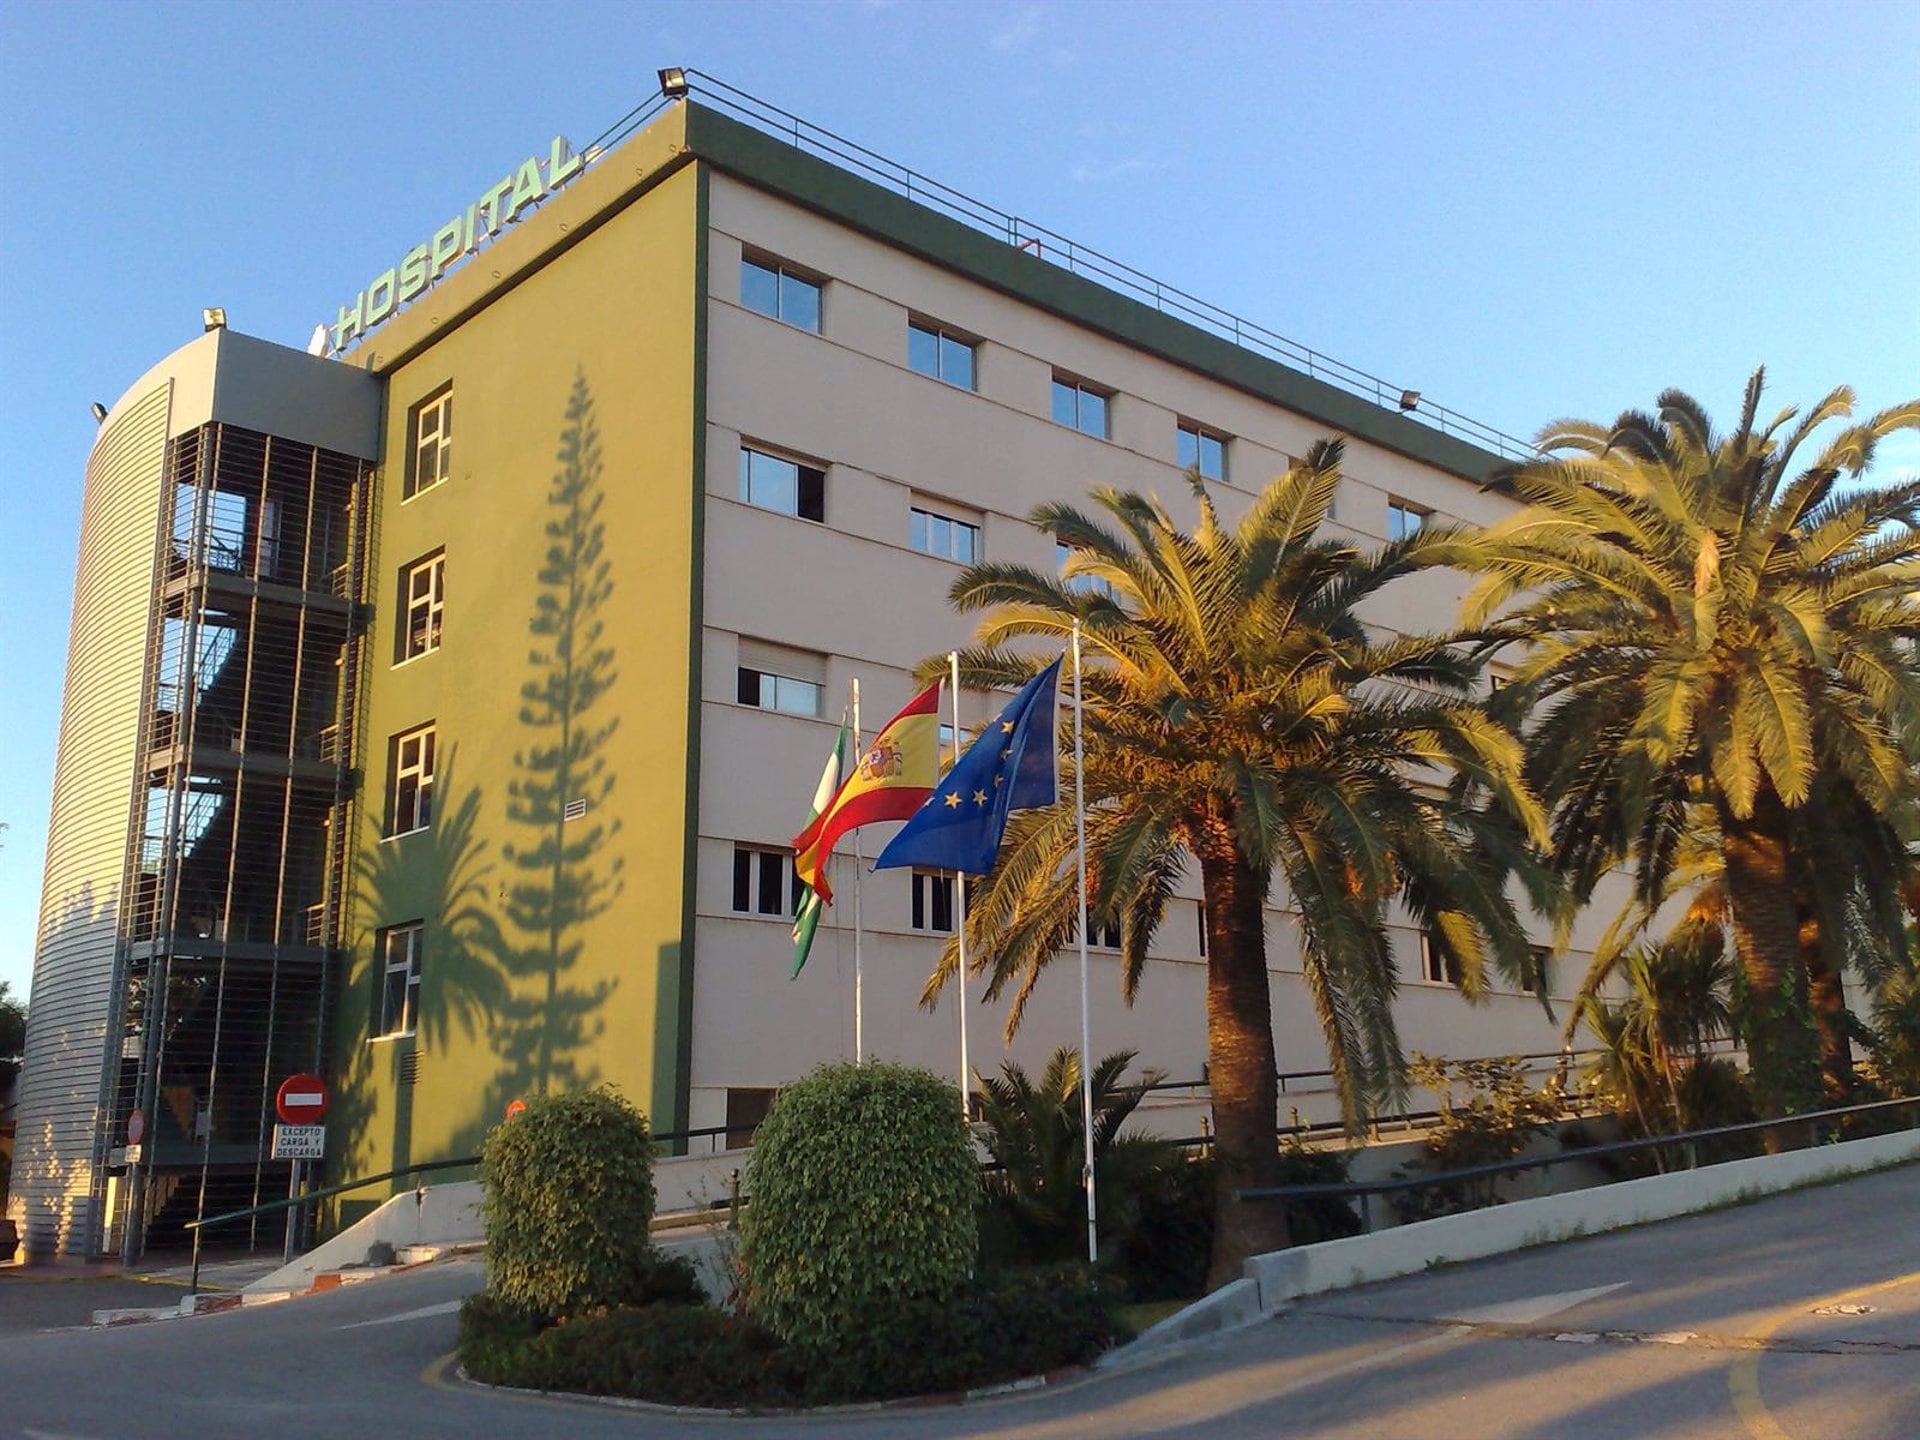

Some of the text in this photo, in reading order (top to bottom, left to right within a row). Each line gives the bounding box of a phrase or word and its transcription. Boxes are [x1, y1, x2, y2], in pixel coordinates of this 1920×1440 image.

[335, 134, 581, 351] HOSPITAL
[282, 1127, 321, 1135] EXCEPTO
[281, 1137, 309, 1145] CARGA
[277, 1148, 321, 1156] DESCARGA
